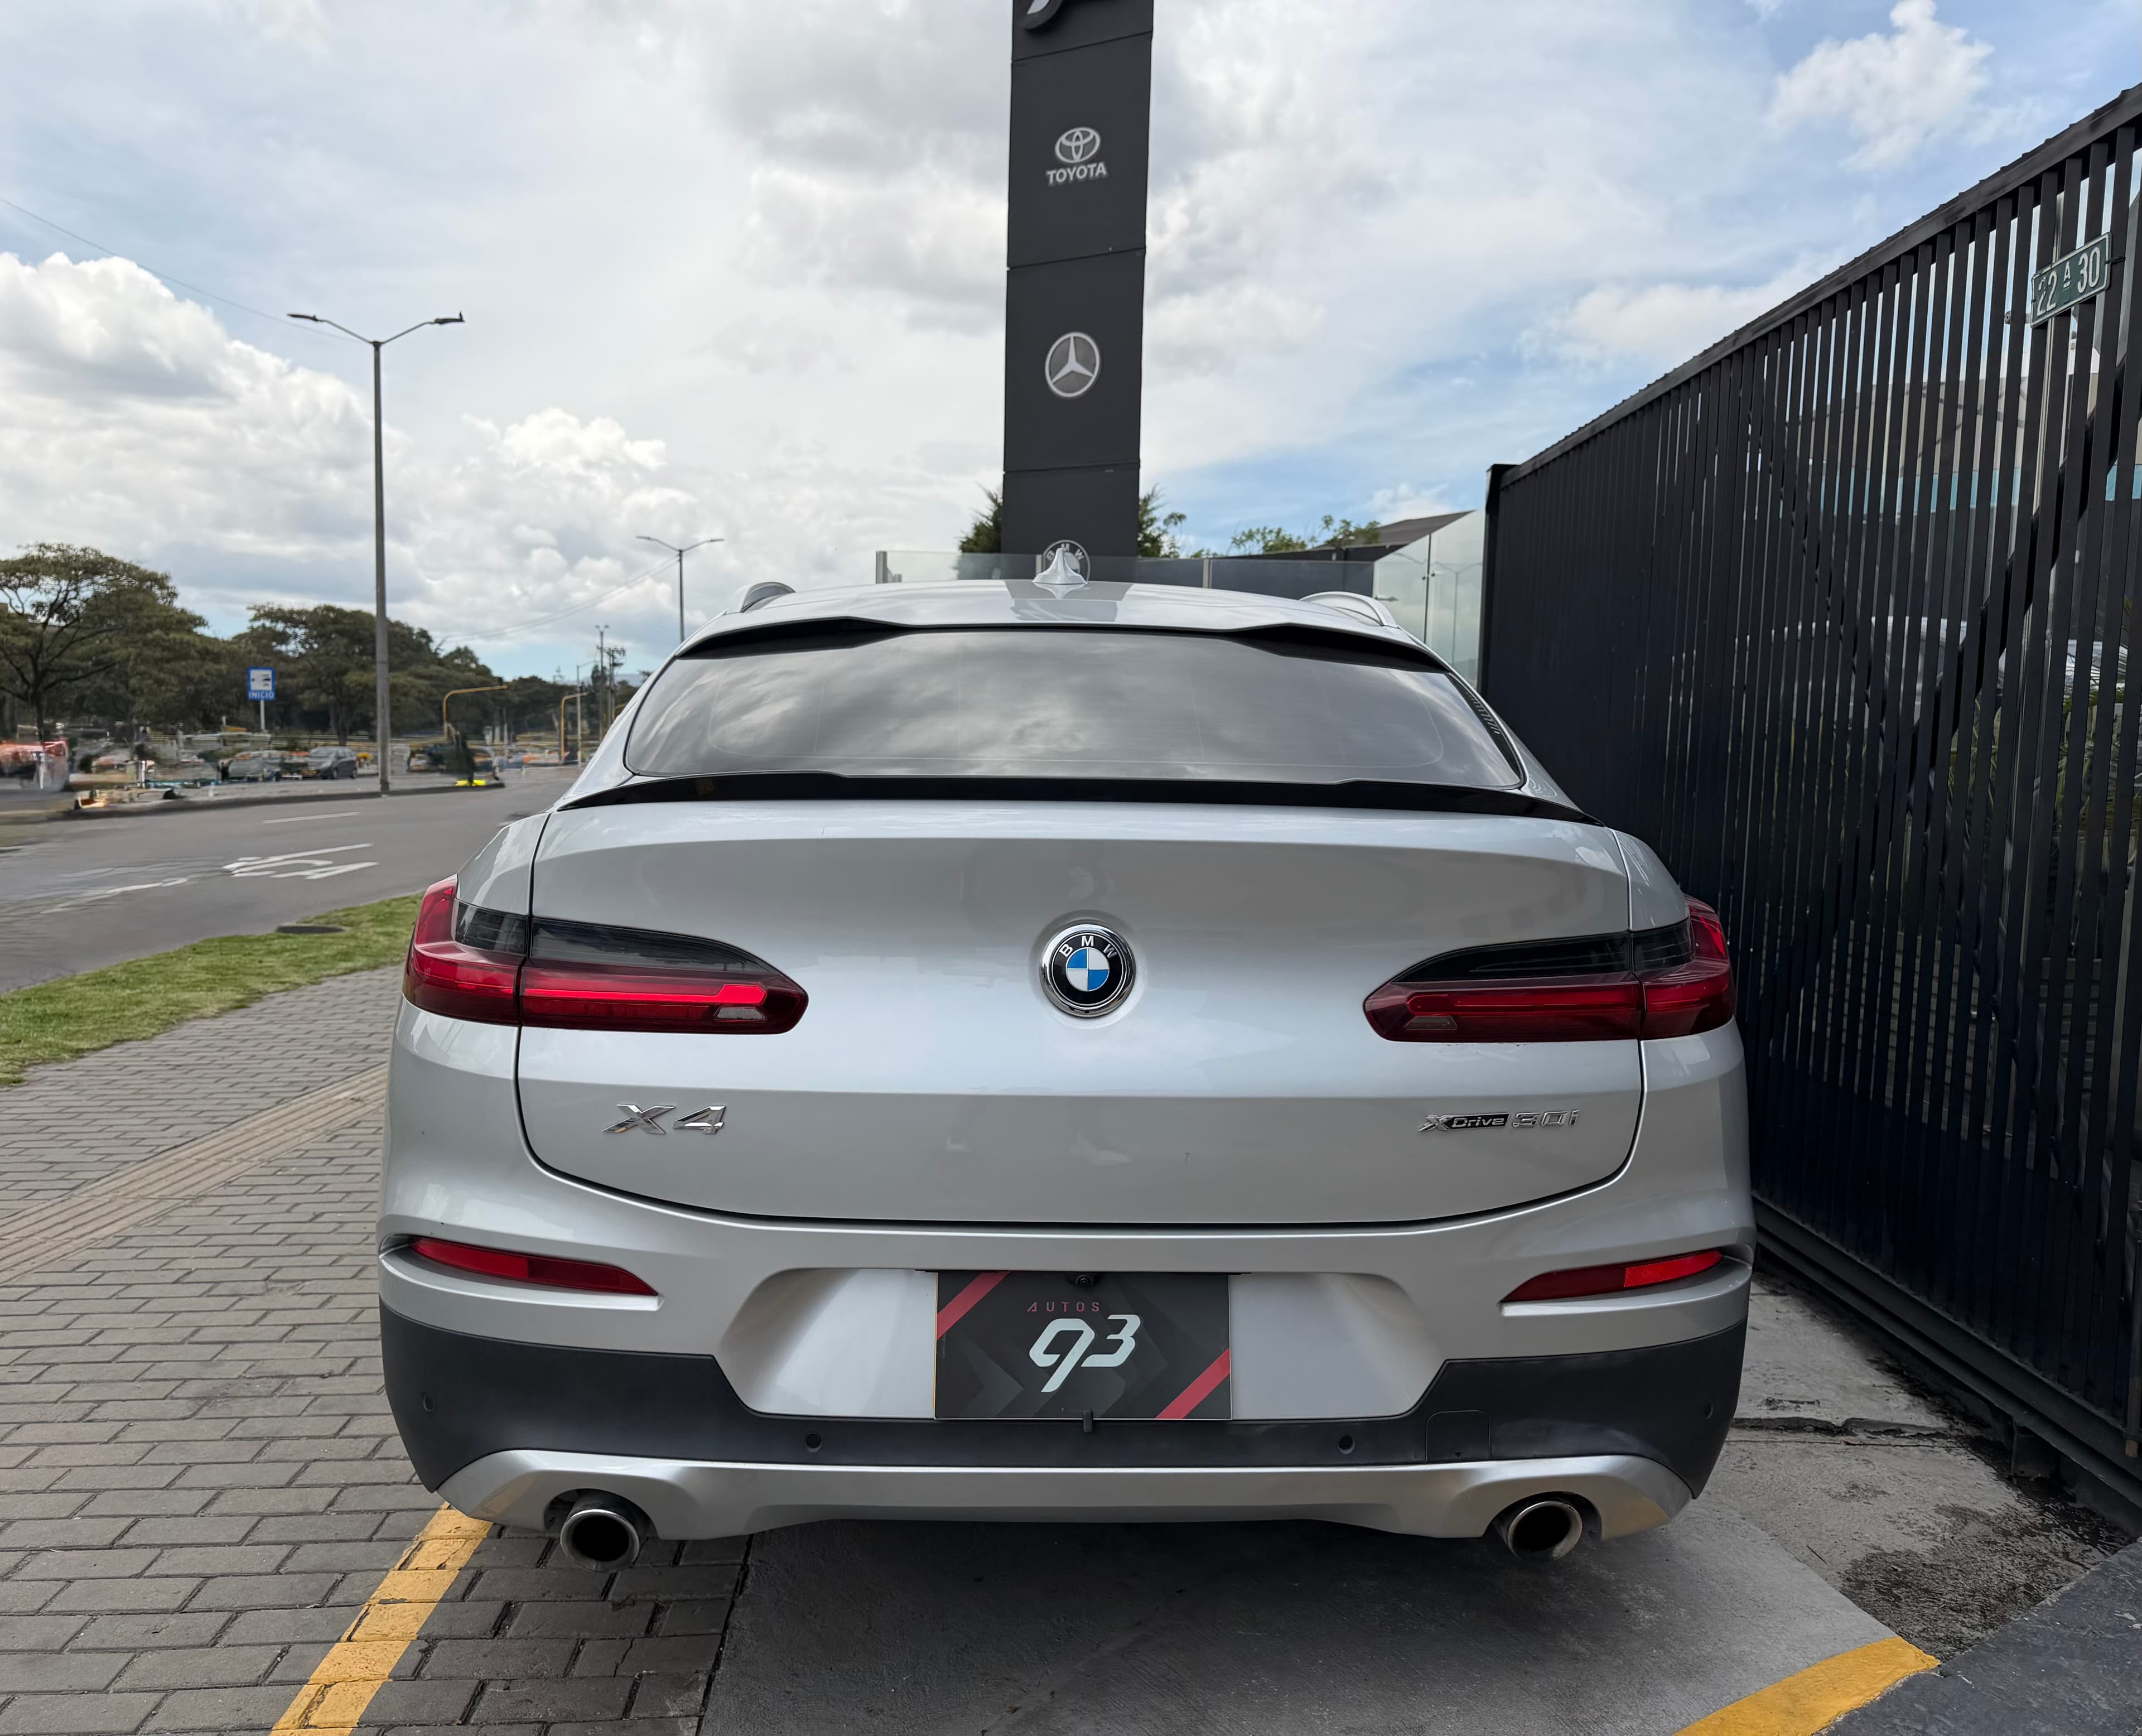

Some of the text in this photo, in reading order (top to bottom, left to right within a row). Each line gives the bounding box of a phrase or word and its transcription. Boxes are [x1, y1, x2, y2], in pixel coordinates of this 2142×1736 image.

[1046, 162, 1107, 184] TOYOTA
[2077, 247, 2101, 294] 30
[249, 691, 274, 700] INICIO
[1059, 935, 1117, 958] BMW
[601, 1103, 726, 1135] X4
[1026, 1301, 1101, 1313] AUTOS
[1029, 1314, 1141, 1393] 93
